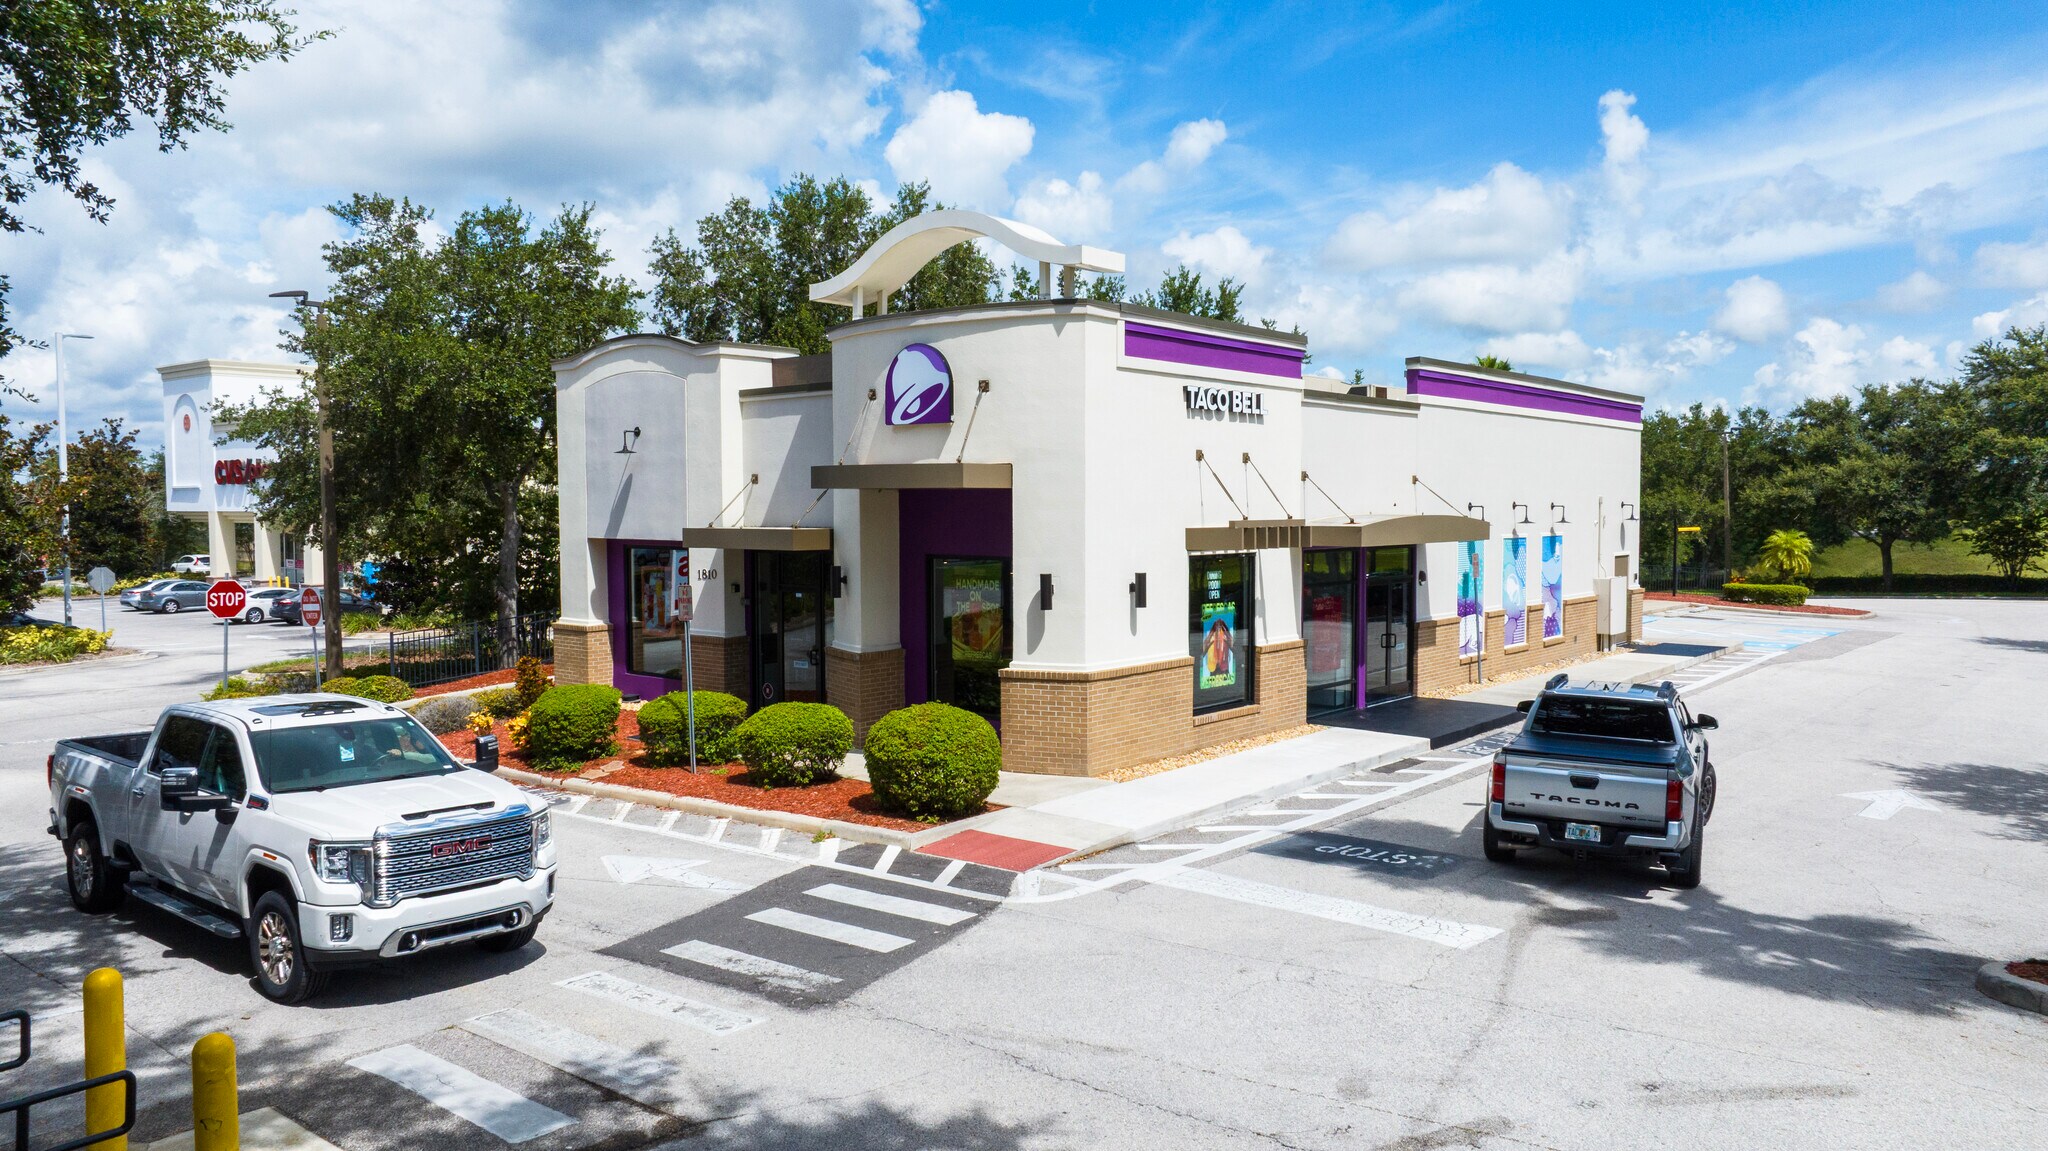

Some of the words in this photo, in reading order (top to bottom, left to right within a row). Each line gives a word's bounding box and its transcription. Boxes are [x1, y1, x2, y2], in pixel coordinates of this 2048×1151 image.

[1184, 385, 1230, 412] TACO
[1230, 390, 1269, 416] BELL
[697, 569, 717, 581] 1810
[955, 579, 1000, 591] HANDMADE
[209, 592, 244, 607] STOP
[969, 590, 982, 600] ON
[1208, 590, 1220, 600] OPEN
[956, 601, 970, 613] THE
[1530, 792, 1639, 810] TACOMA
[432, 836, 493, 857] GMC
[1314, 844, 1417, 864] STOP
